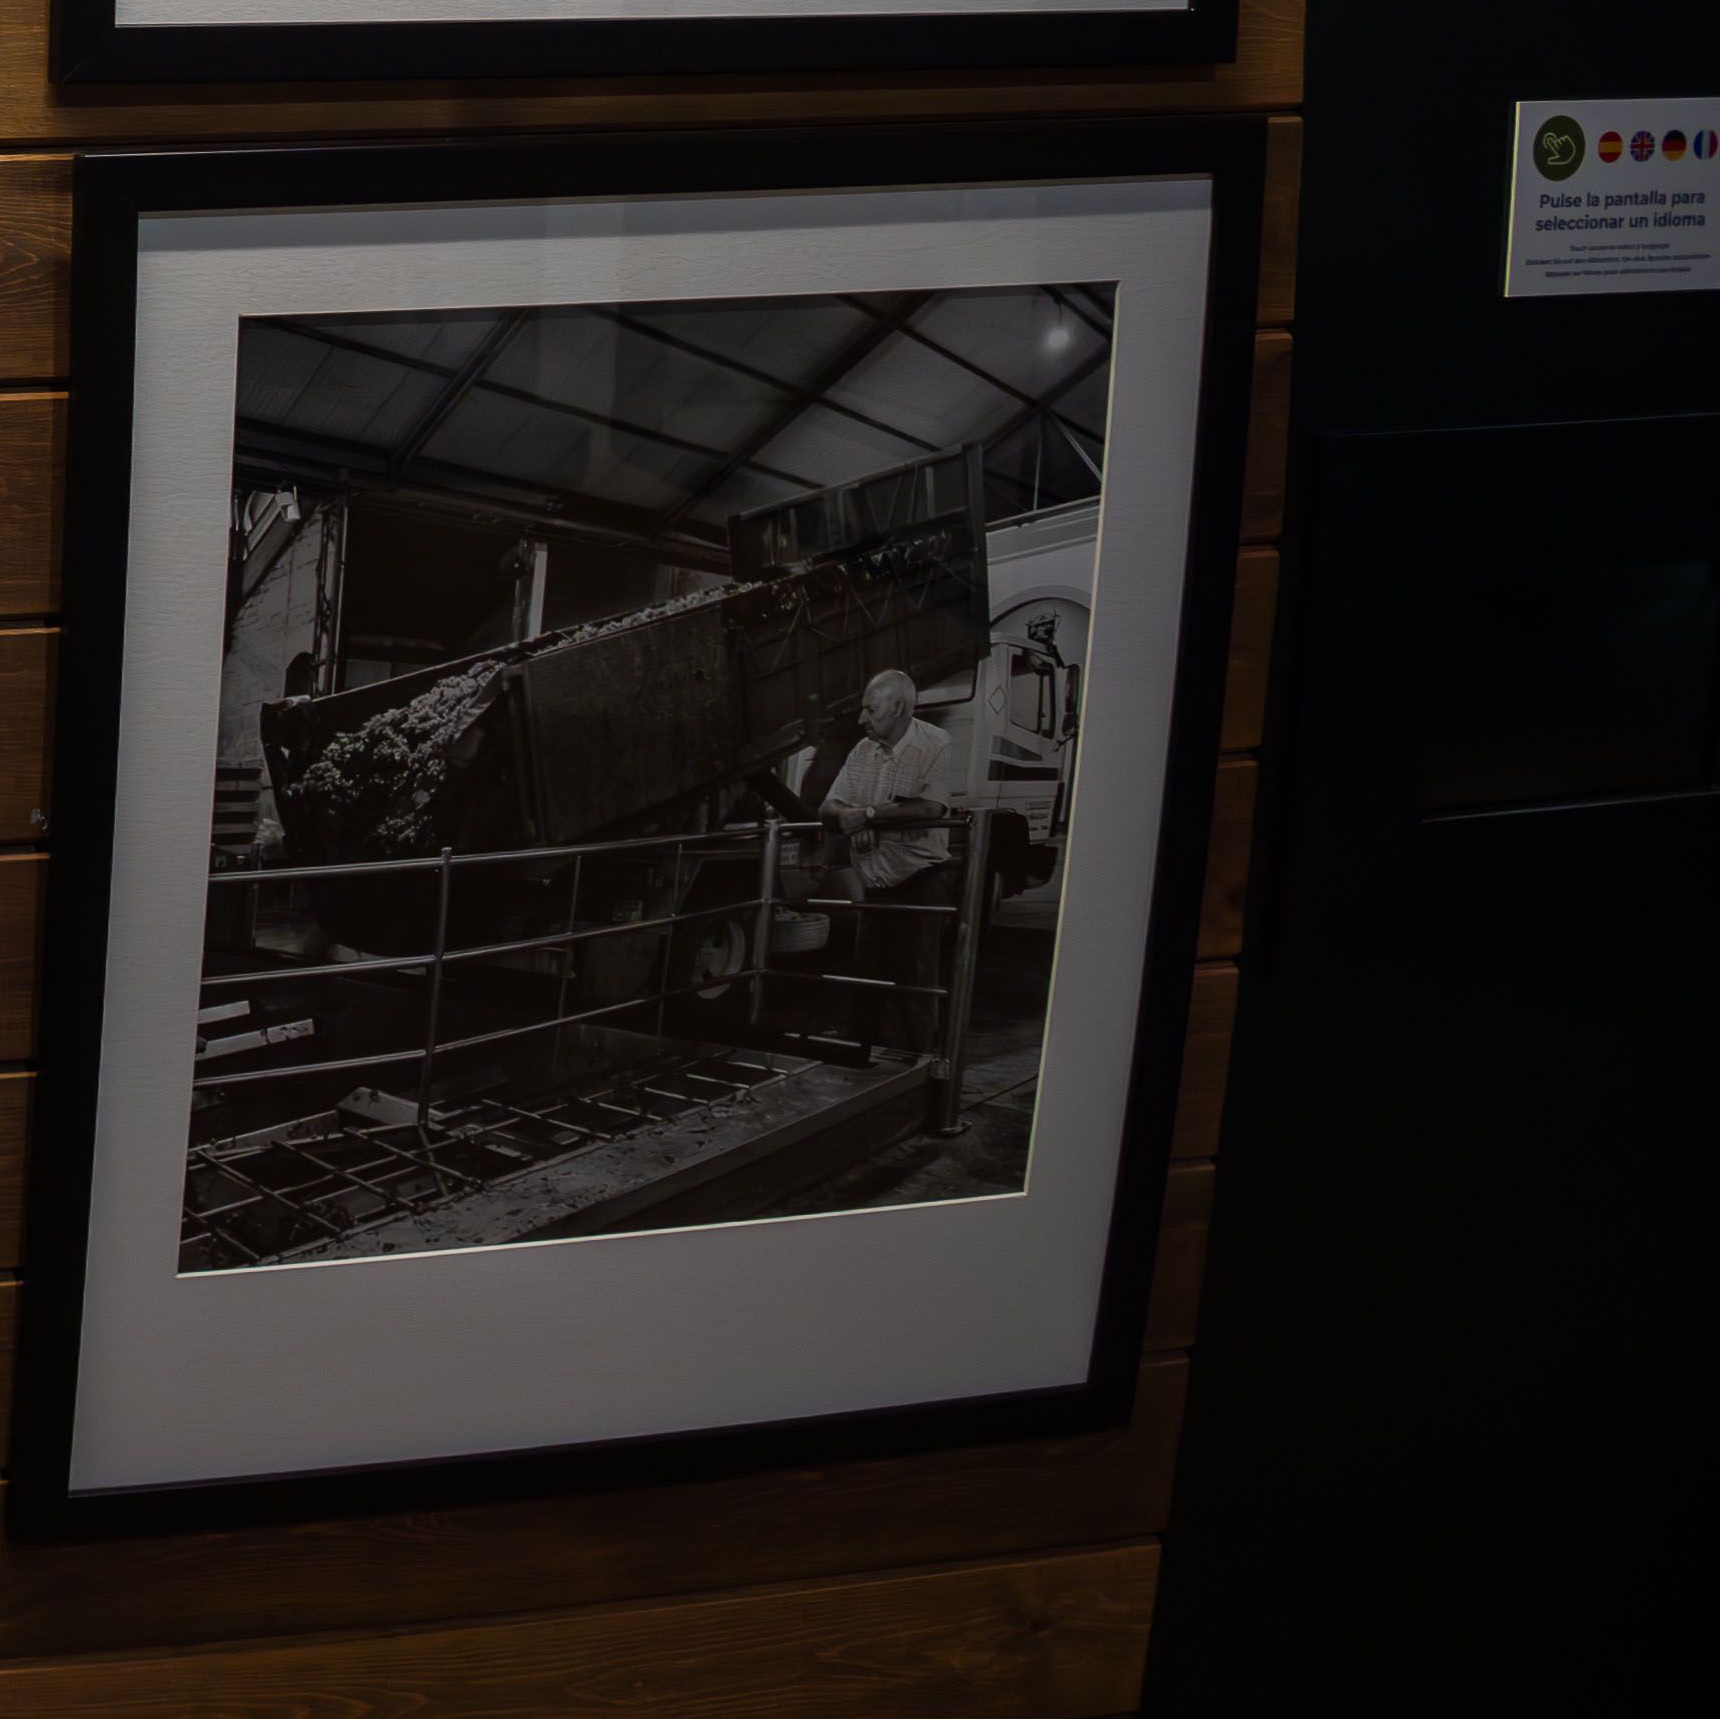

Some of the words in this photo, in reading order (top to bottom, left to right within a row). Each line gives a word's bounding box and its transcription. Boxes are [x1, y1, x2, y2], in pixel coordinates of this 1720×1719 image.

[1539, 193, 1582, 209] Pulse
[1587, 191, 1600, 207] la
[1604, 190, 1667, 210] pantalla
[1671, 191, 1706, 207] para
[1535, 214, 1625, 231] seleccionar
[1629, 216, 1649, 229] un
[1653, 211, 1706, 228] idioma
